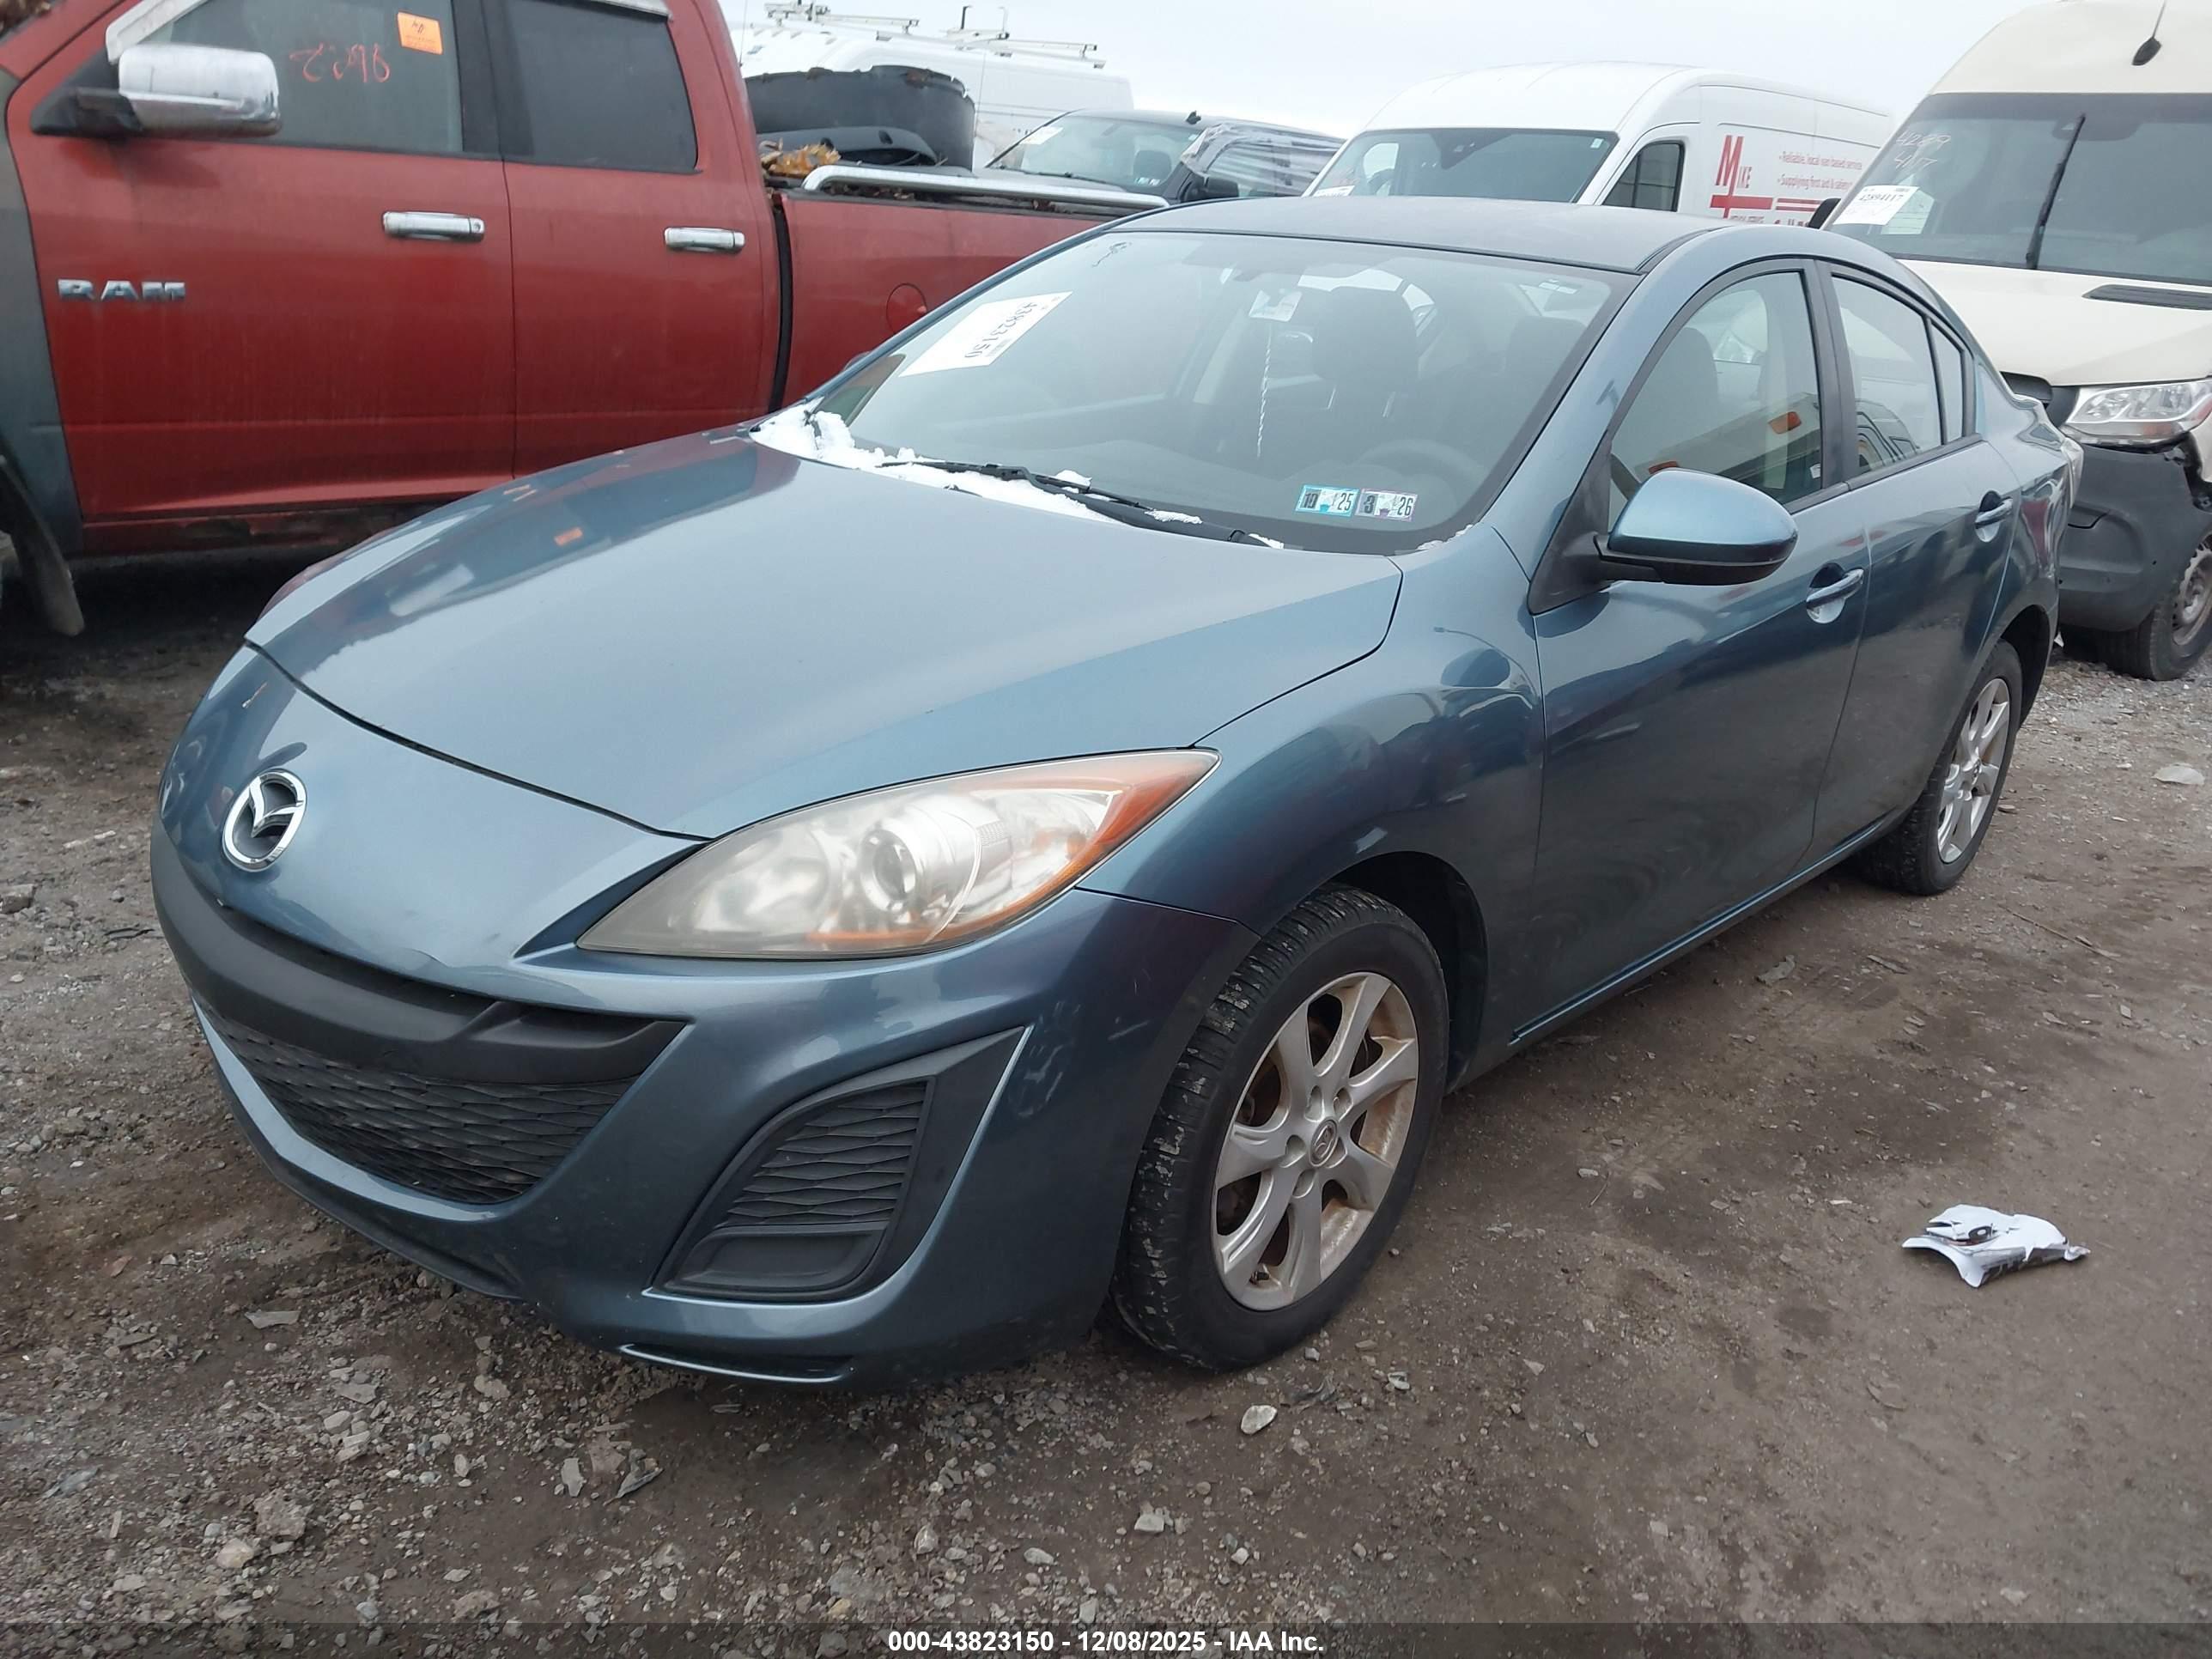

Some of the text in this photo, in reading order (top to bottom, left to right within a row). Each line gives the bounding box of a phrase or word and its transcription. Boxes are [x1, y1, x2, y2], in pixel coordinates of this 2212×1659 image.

[57, 277, 186, 301] RAM
[963, 302, 1038, 359] 43823150
[1303, 492, 1354, 511] 10 25
[1363, 495, 1414, 516] 3 26
